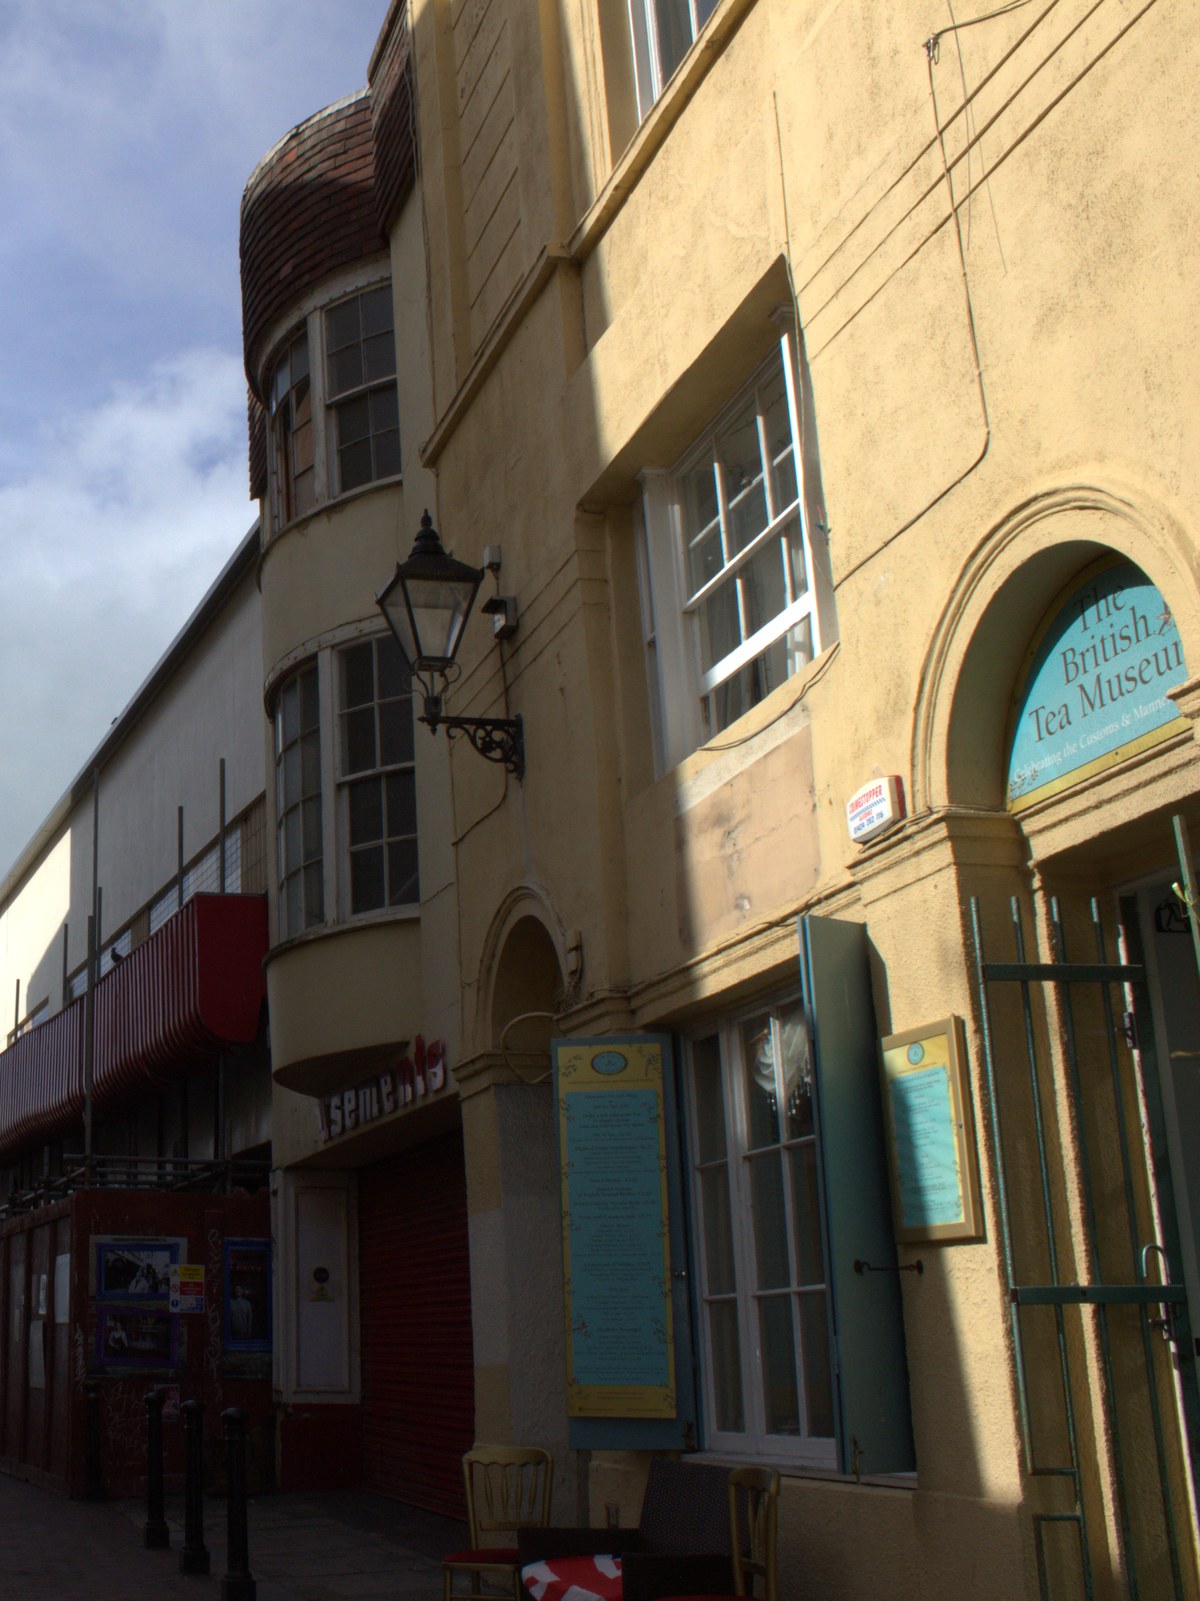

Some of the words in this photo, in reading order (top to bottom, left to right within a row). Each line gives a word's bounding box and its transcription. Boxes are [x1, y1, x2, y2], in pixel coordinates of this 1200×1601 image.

[1072, 582, 1128, 634] The
[1060, 605, 1152, 685] British
[1014, 750, 1062, 782] Celebrating
[1063, 741, 1078, 757] the
[1079, 722, 1120, 749] Customs
[1121, 713, 1132, 727] &
[1028, 702, 1072, 743] Tea
